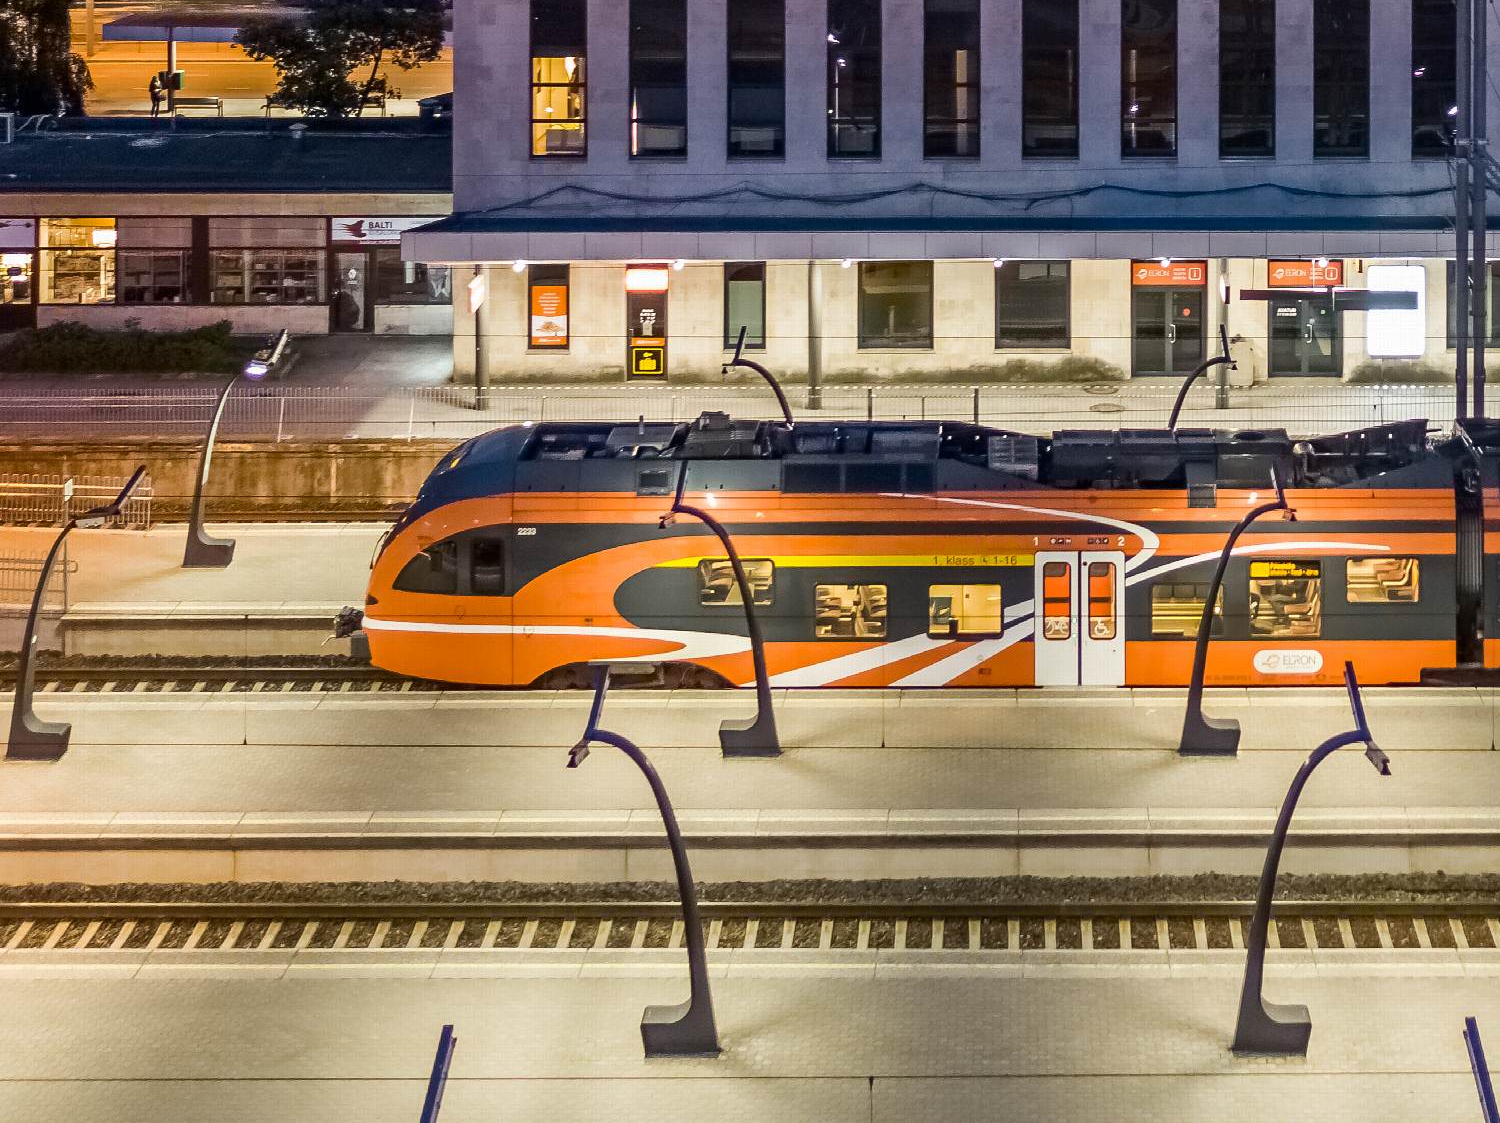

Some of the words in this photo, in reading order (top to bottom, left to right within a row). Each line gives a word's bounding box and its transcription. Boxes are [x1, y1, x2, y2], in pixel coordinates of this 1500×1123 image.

[368, 221, 393, 229] BALTI
[1033, 537, 1039, 546] 1
[1117, 536, 1125, 546] 2
[946, 555, 975, 565] klass
[993, 555, 1018, 565] 1-16
[1282, 655, 1316, 666] ELRON
